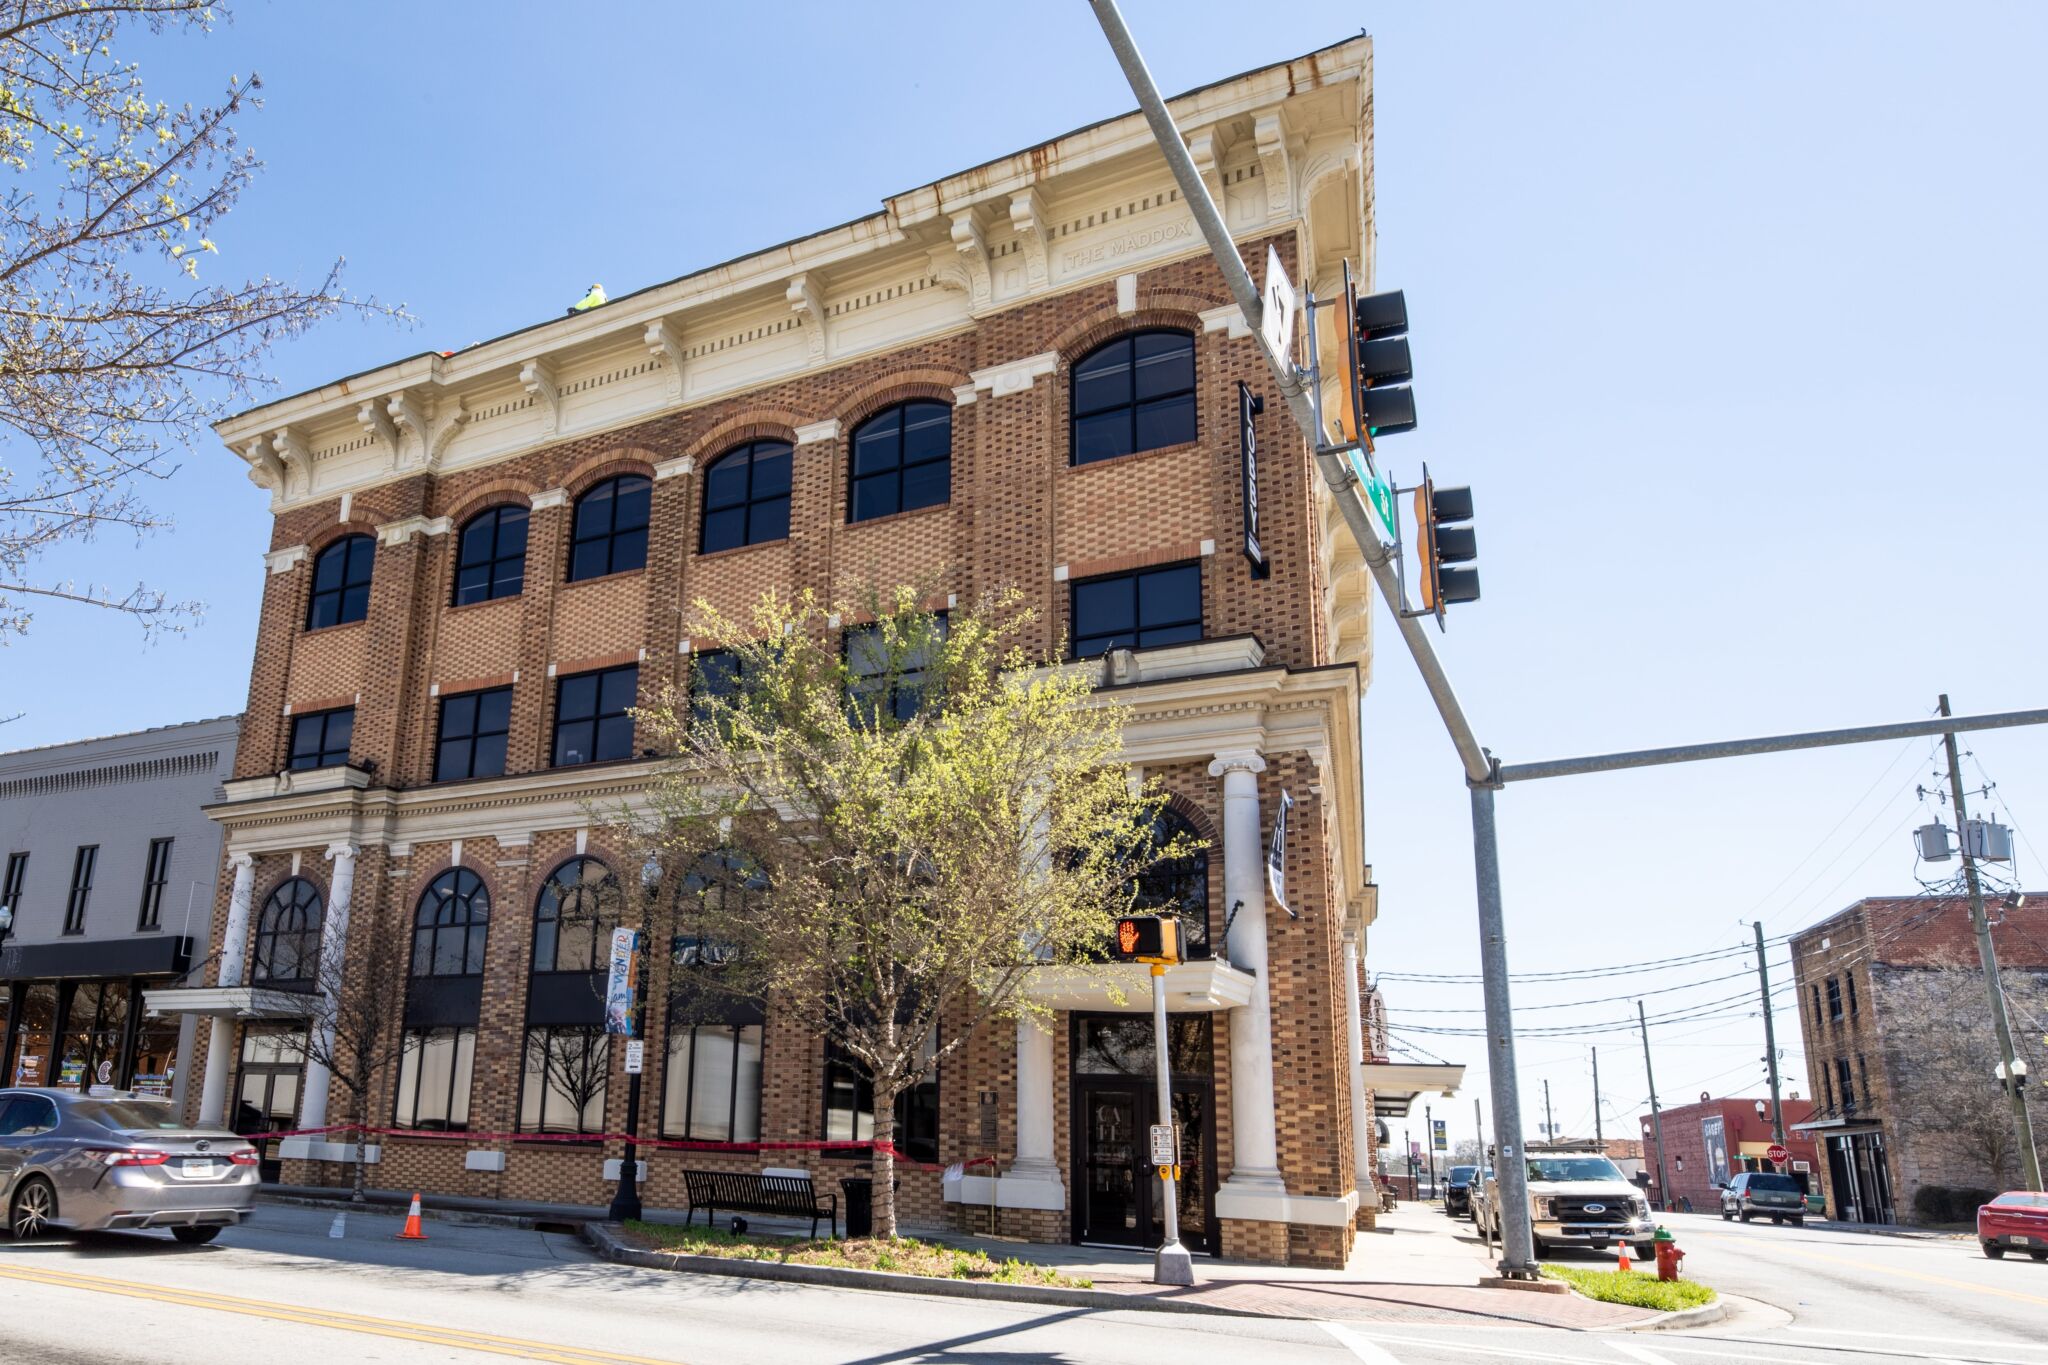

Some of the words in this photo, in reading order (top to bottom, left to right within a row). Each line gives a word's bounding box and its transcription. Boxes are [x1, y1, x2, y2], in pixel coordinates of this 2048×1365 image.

[1067, 246, 1104, 268] THE
[1111, 220, 1192, 257] MADDOX
[1247, 398, 1257, 533] LOBBY
[1768, 1150, 1786, 1158] STOP
